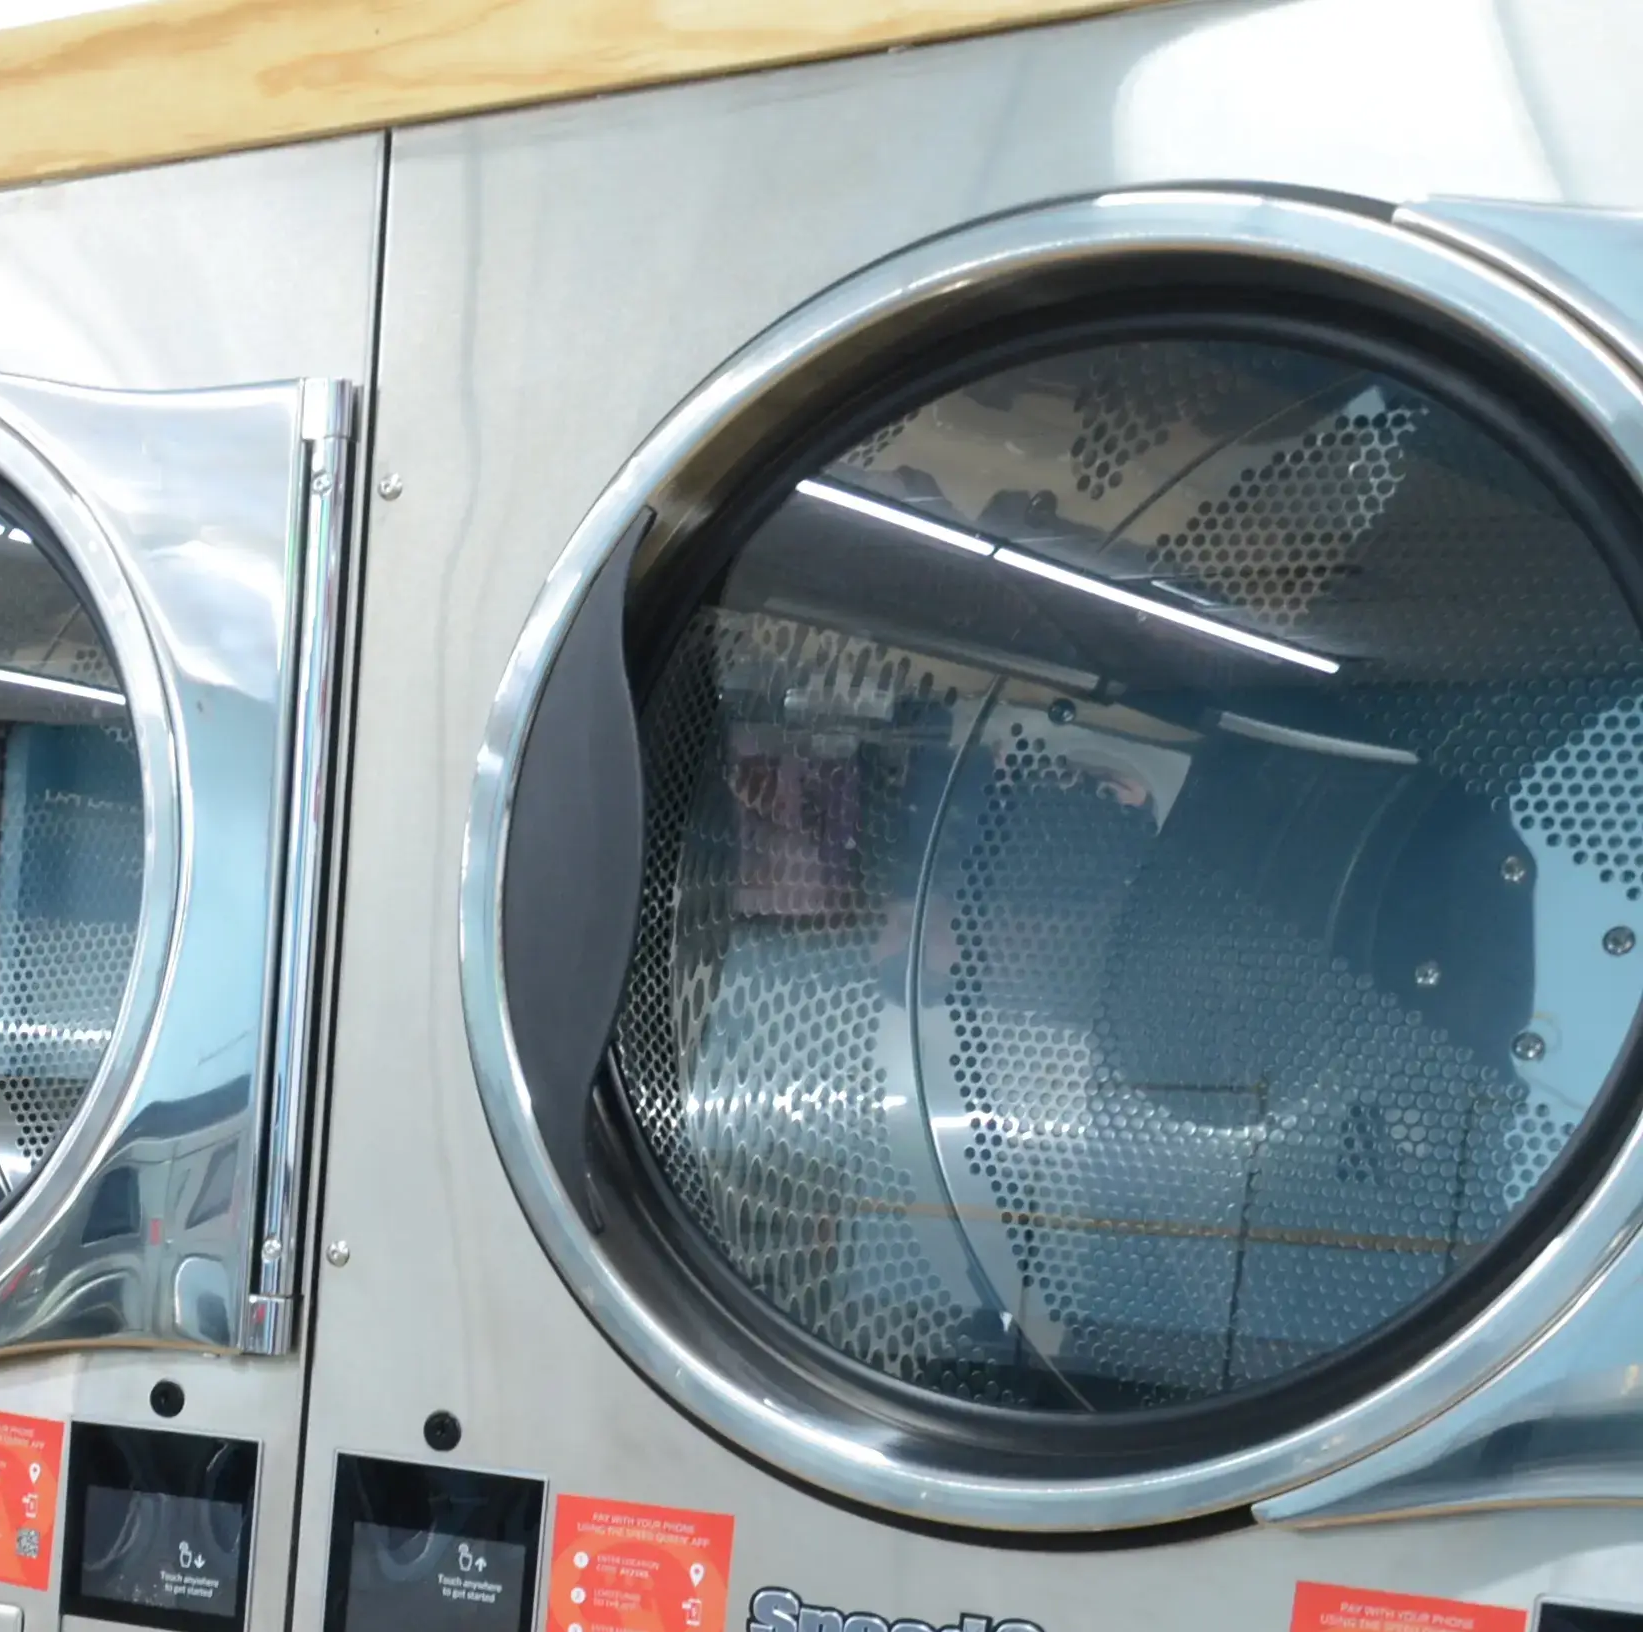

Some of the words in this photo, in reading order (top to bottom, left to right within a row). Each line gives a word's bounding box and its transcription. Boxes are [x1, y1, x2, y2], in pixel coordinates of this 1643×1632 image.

[160, 1571, 183, 1583] Touch
[183, 1576, 219, 1588] anywhere
[438, 1573, 462, 1586] Touch
[462, 1579, 502, 1593] anywhere
[187, 1587, 213, 1598] started
[467, 1591, 495, 1603] started
